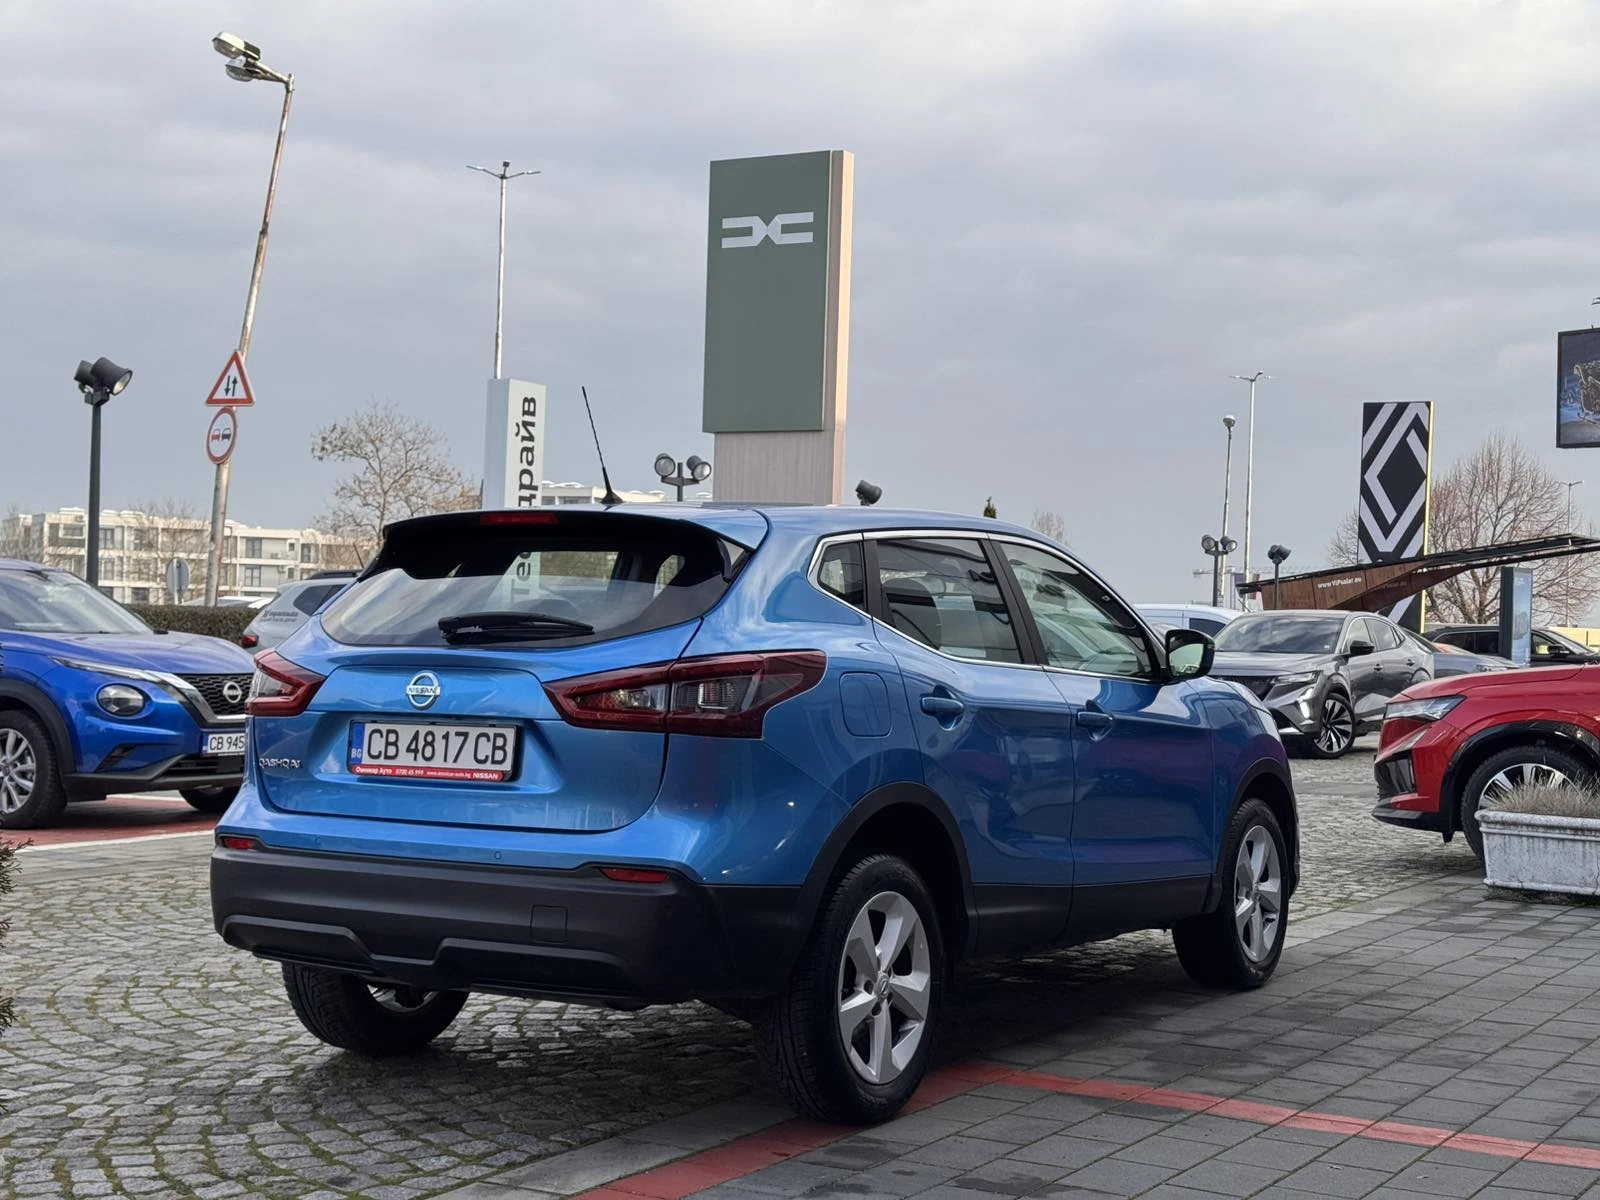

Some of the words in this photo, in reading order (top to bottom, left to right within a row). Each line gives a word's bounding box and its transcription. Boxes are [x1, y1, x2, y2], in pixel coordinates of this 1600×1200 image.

[408, 686, 436, 694] NISSAN
[209, 736, 224, 751] CB
[351, 748, 362, 759] BG
[367, 728, 400, 761] CB
[405, 729, 470, 764] 4817
[473, 732, 508, 765] CB
[259, 758, 302, 769] QASHQAI
